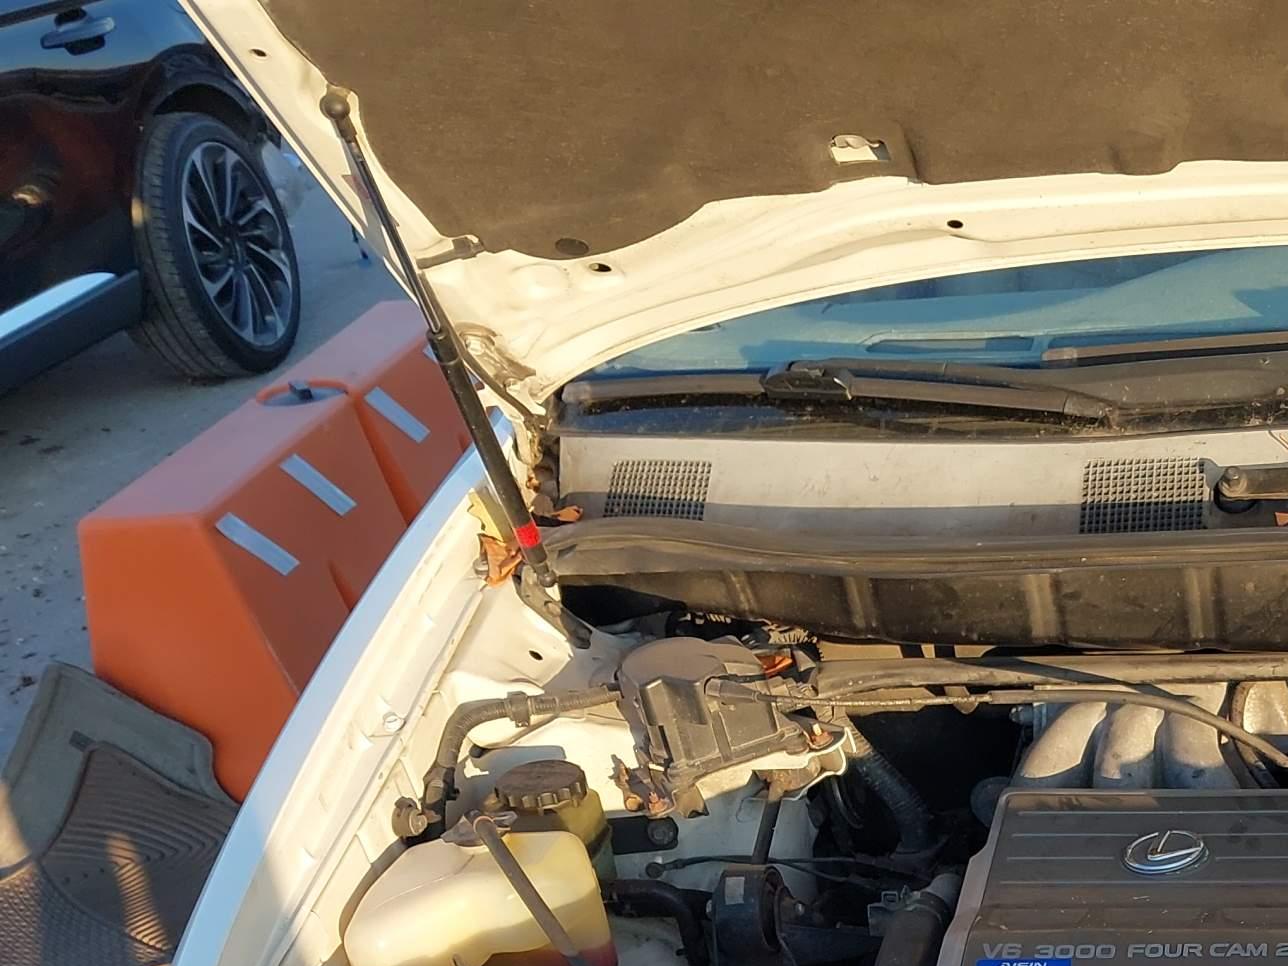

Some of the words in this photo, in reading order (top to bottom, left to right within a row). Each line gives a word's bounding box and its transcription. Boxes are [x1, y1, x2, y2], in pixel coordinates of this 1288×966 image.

[983, 943, 1023, 959] V6
[1034, 943, 1116, 959] 3000
[1127, 943, 1203, 959] FOUR
[1209, 943, 1268, 958] CAM
